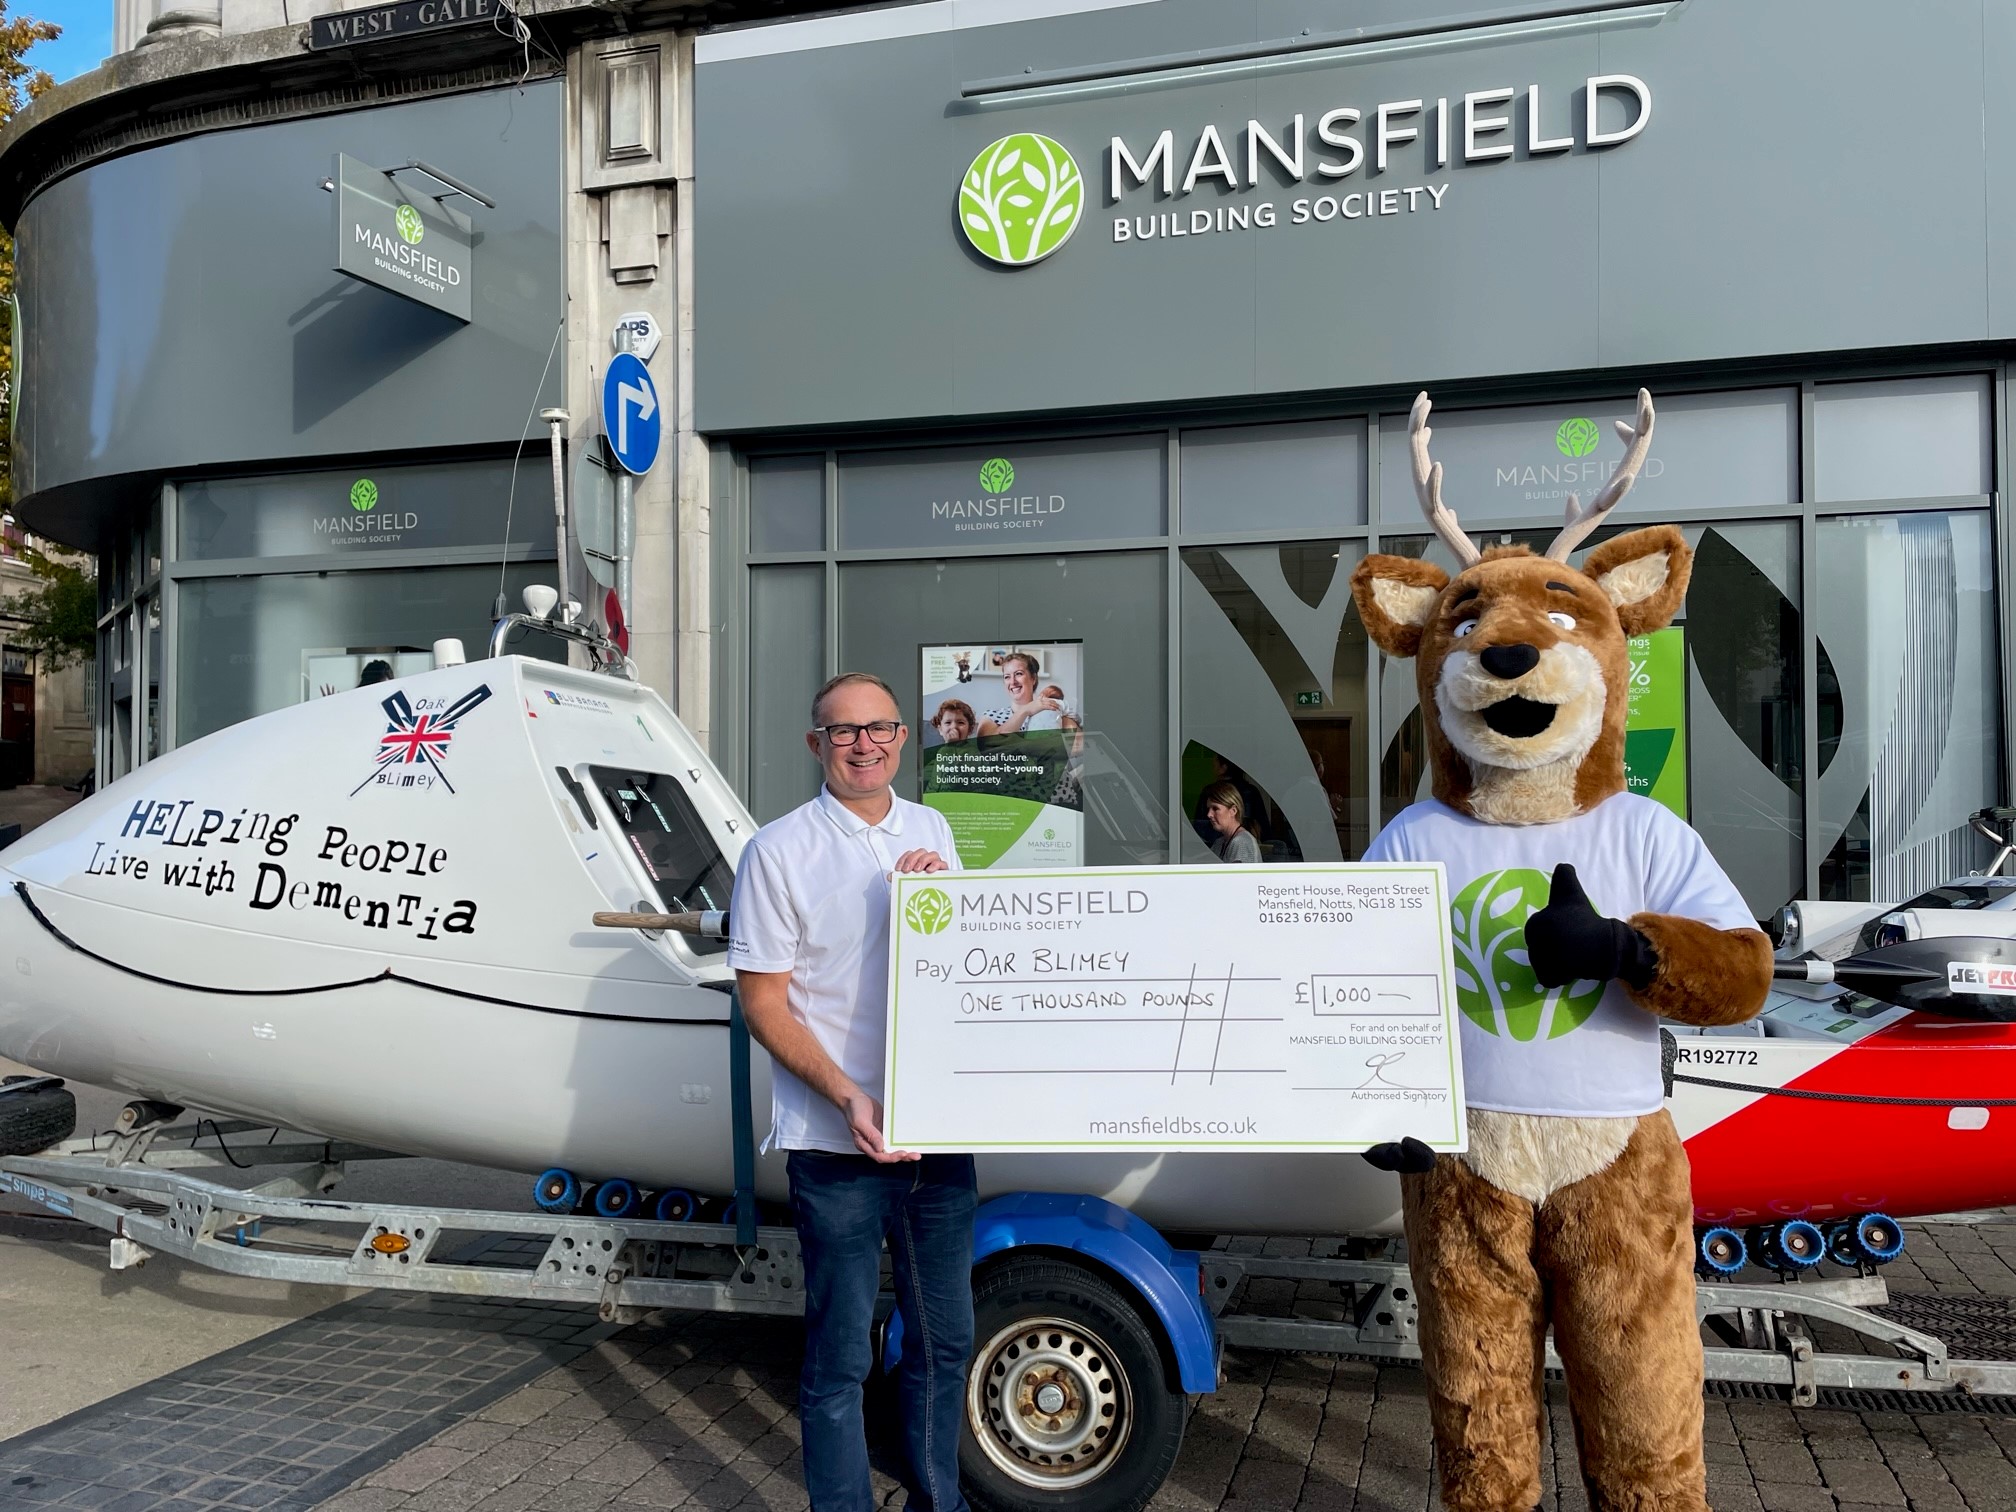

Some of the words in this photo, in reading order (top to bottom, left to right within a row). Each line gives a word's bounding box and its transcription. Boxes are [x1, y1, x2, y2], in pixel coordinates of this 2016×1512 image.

[328, 10, 396, 40] WEST
[418, 0, 489, 24] GATE
[1111, 74, 1652, 200] MANSFIELD
[1113, 202, 1276, 242] BUILDING
[1291, 183, 1449, 225] SOCIETY
[356, 224, 460, 286] MANSFIELD
[374, 257, 412, 280] BUILDING
[413, 274, 445, 294] SOCIETY
[1496, 458, 1665, 487] MANSFID
[1525, 488, 1581, 500] BUILDING
[932, 495, 1065, 519] MANSFIELD
[313, 512, 418, 534] MANSFIELD
[955, 522, 1000, 531] BUILDING
[1003, 520, 1044, 529] SOCIETY
[331, 536, 367, 545] BUILDING
[369, 534, 402, 543] SOCIETY
[936, 753, 962, 764] Bright
[964, 753, 998, 762] financial
[1000, 753, 1029, 762] future.
[936, 764, 959, 773] Meet
[960, 764, 976, 773] the
[978, 764, 1044, 774] start-it-young
[936, 775, 968, 785] building
[970, 775, 1002, 785] society.
[84, 842, 149, 880] Live
[163, 856, 234, 896] with
[1258, 885, 1300, 898] Regent
[1303, 885, 1344, 897] House,
[1348, 884, 1390, 898] Regent
[1392, 884, 1430, 895] Street
[961, 890, 1149, 916] MANSFIELD
[1258, 898, 1316, 911] Mansfield,
[1320, 899, 1356, 910] Notts,
[1358, 898, 1396, 909] NG18
[1400, 898, 1423, 909] 1SS
[960, 922, 1022, 932] BUILDING
[1027, 920, 1082, 930] SOCIETY
[1260, 912, 1300, 923] 01623
[1304, 912, 1353, 923] 676300
[916, 959, 953, 982] Pay
[964, 948, 1016, 976] OAR
[1032, 948, 1130, 973] BLIMEY
[1951, 968, 2016, 986] JETPR
[1295, 982, 1310, 1004] £
[961, 992, 1004, 1014] ONE
[1012, 992, 1127, 1012] THOUSAND
[1143, 992, 1214, 1007] POUNDS
[1350, 1024, 1366, 1032] For
[1368, 1024, 1384, 1032] and
[1402, 1023, 1429, 1032] behalf
[1432, 1023, 1442, 1032] of
[1290, 1036, 1346, 1045] MANSFIELD
[1350, 1036, 1397, 1045] BUILDING
[1400, 1036, 1443, 1045] SOCIETY
[1678, 1049, 1758, 1065] R192772
[1351, 1091, 1400, 1100] Authorised
[1403, 1091, 1447, 1102] Signatory
[1090, 1116, 1257, 1134] mansfieldbs.co.uk
[13, 1178, 46, 1202] snipe
